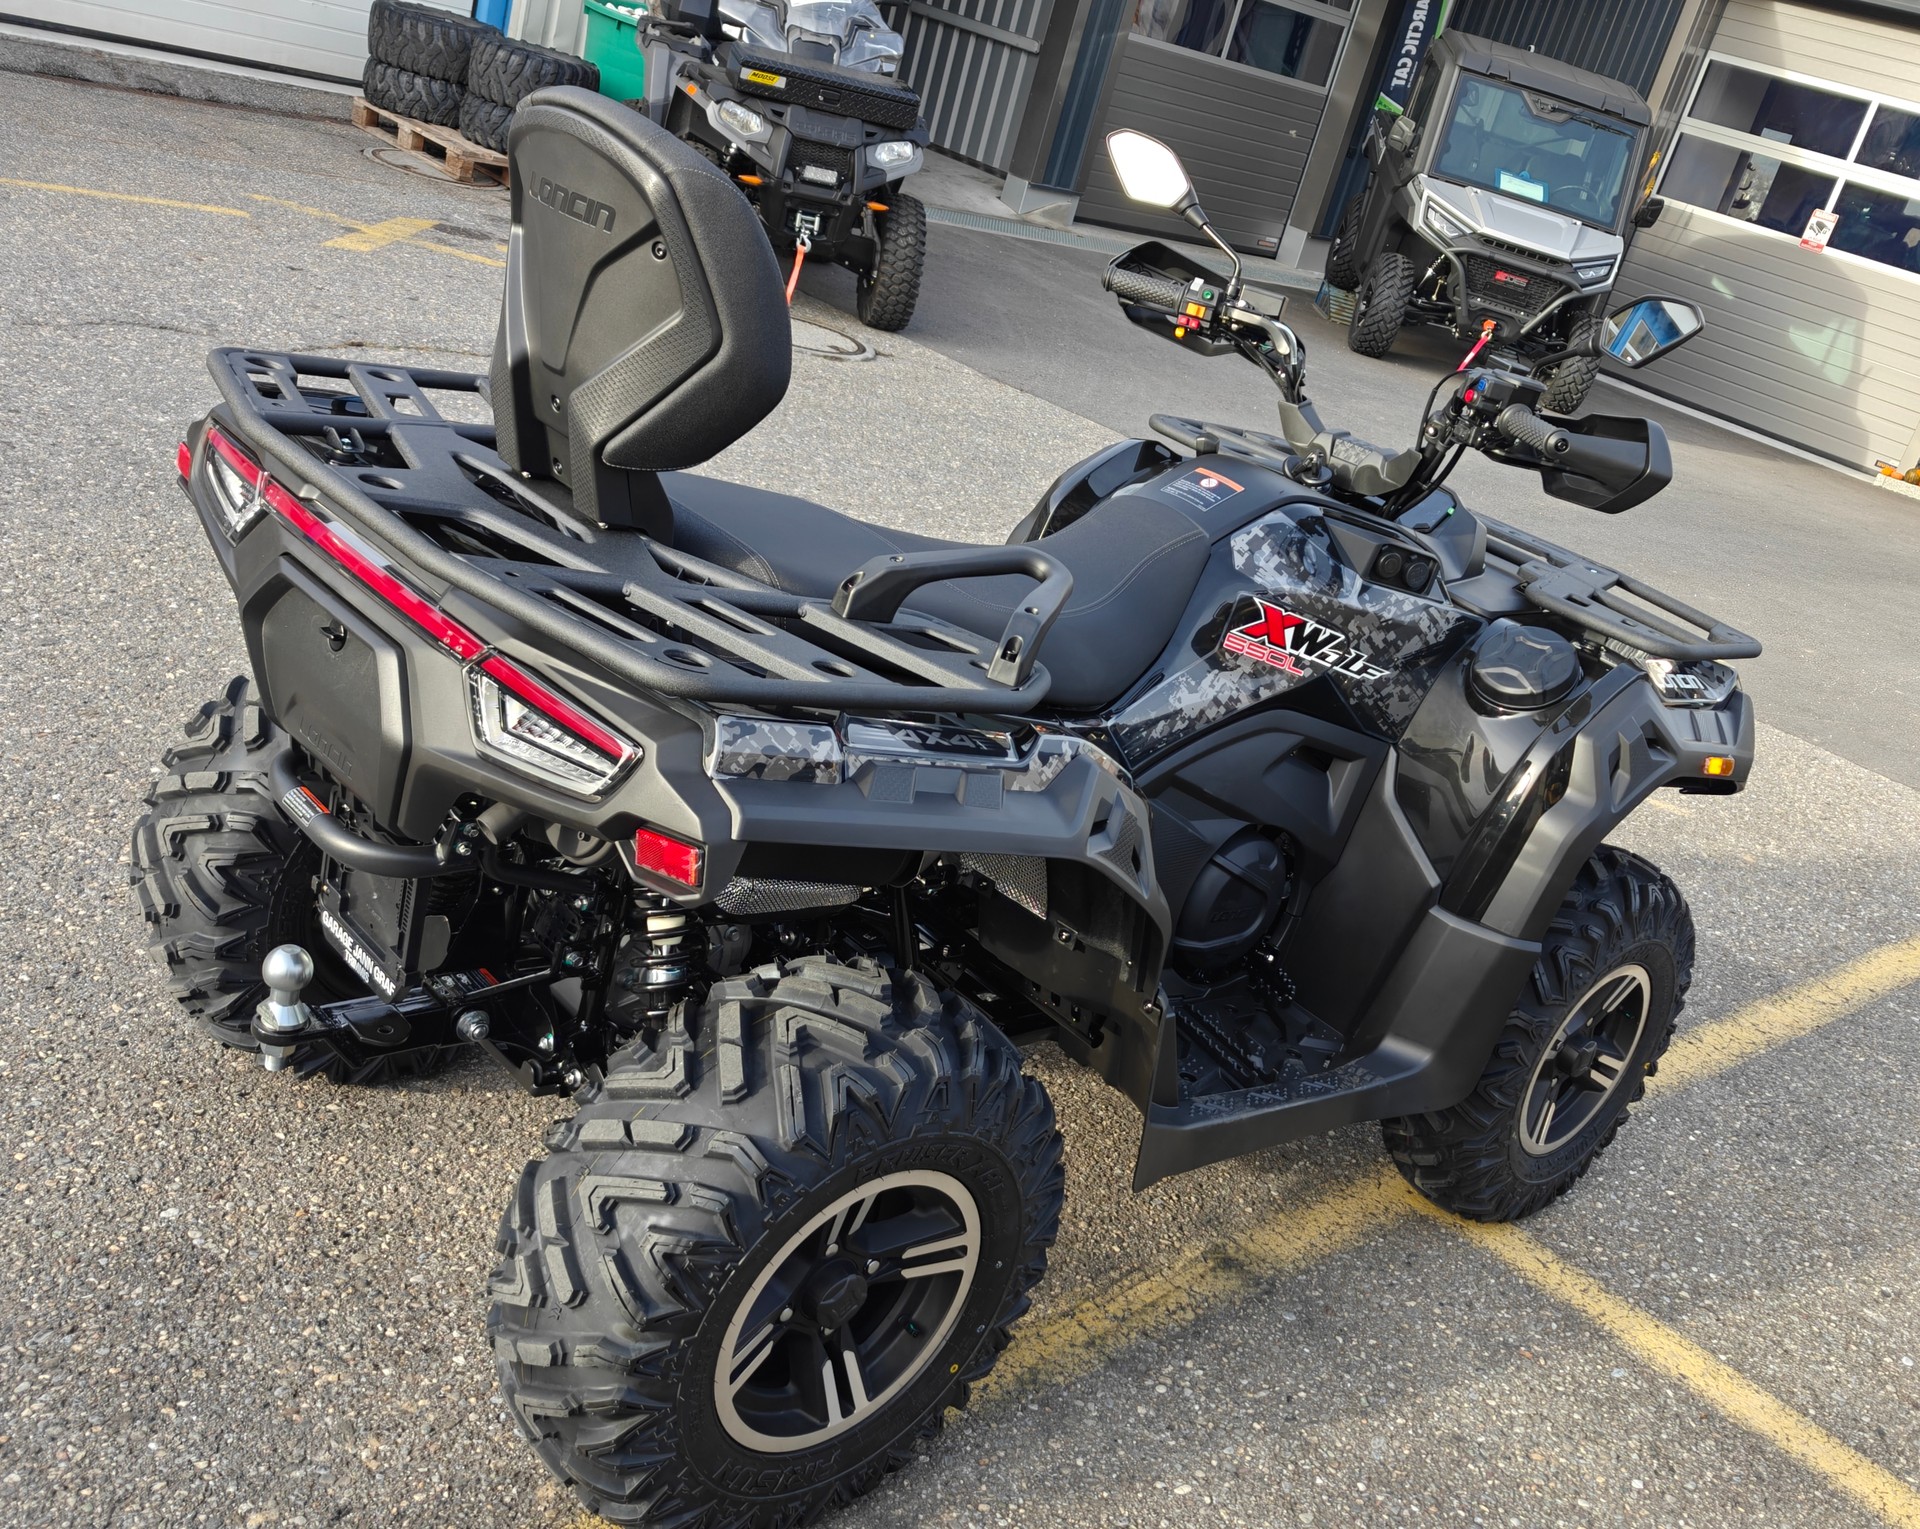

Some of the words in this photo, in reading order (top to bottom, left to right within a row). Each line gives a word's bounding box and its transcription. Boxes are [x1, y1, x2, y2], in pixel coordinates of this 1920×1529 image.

[529, 171, 617, 234] LONCIN
[1223, 633, 1304, 677] 550L
[322, 910, 354, 952] GARAGE
[353, 944, 374, 975] JANN
[373, 966, 396, 996] GRAF
